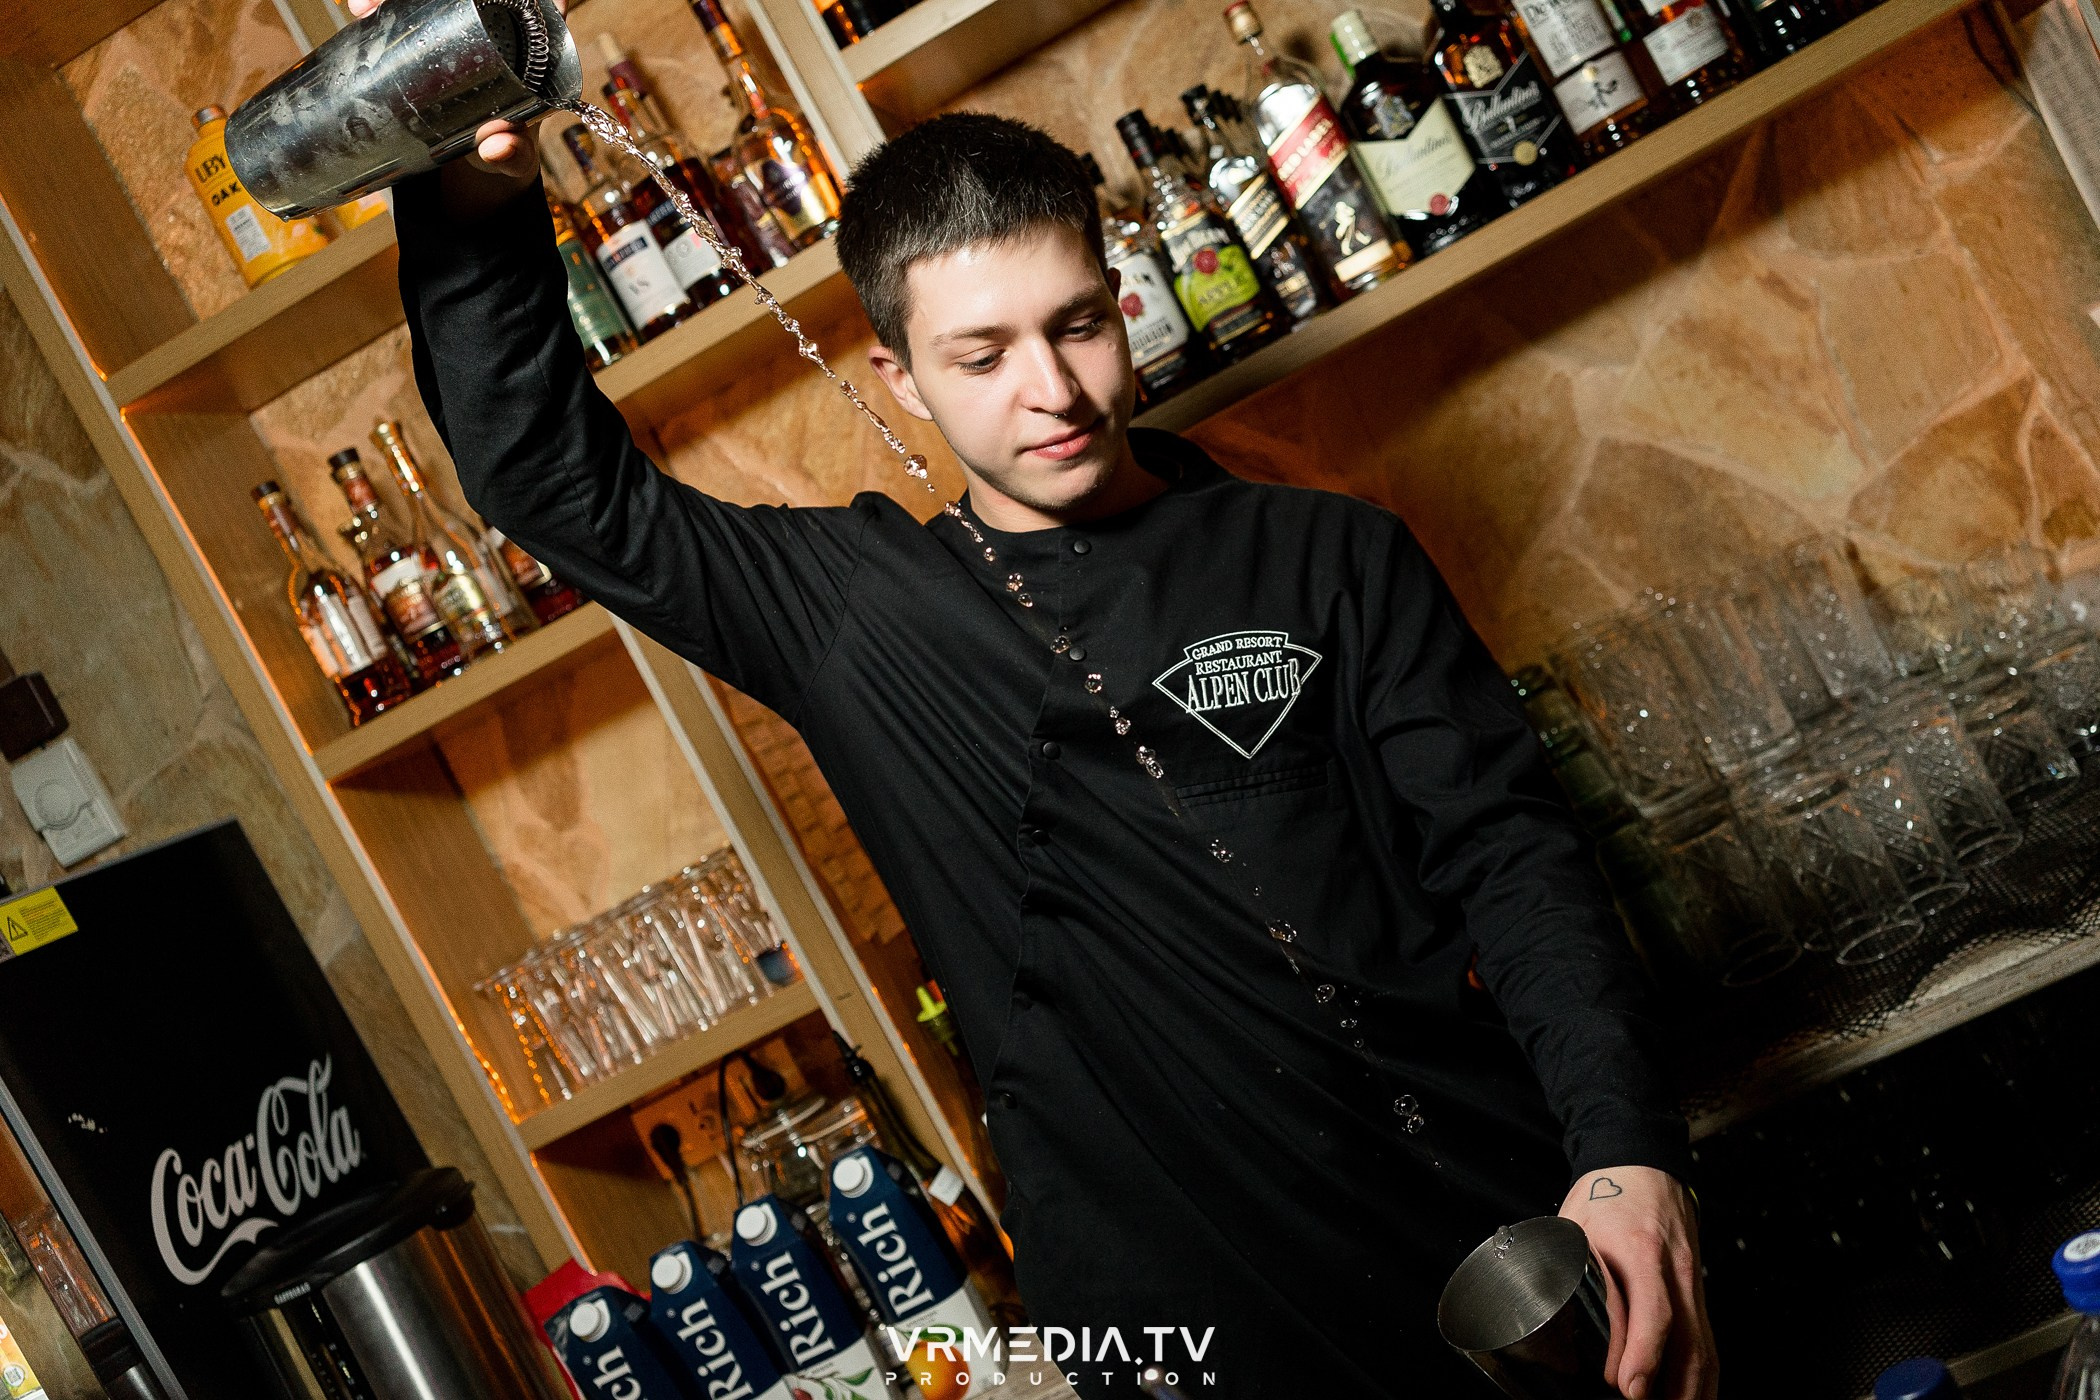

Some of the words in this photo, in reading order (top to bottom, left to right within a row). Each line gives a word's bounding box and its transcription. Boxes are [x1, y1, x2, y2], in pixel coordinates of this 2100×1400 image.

[1186, 671, 1251, 713] ALPEN
[1252, 657, 1301, 703] CLUB
[1191, 639, 1233, 661] GRAND
[1235, 636, 1283, 649] RESORT
[1194, 650, 1283, 676] RESTAURANT
[151, 1052, 361, 1285] Coca-Cola
[760, 1251, 836, 1367] Rich
[857, 1201, 934, 1317] Rich
[677, 1297, 754, 1400] Rich
